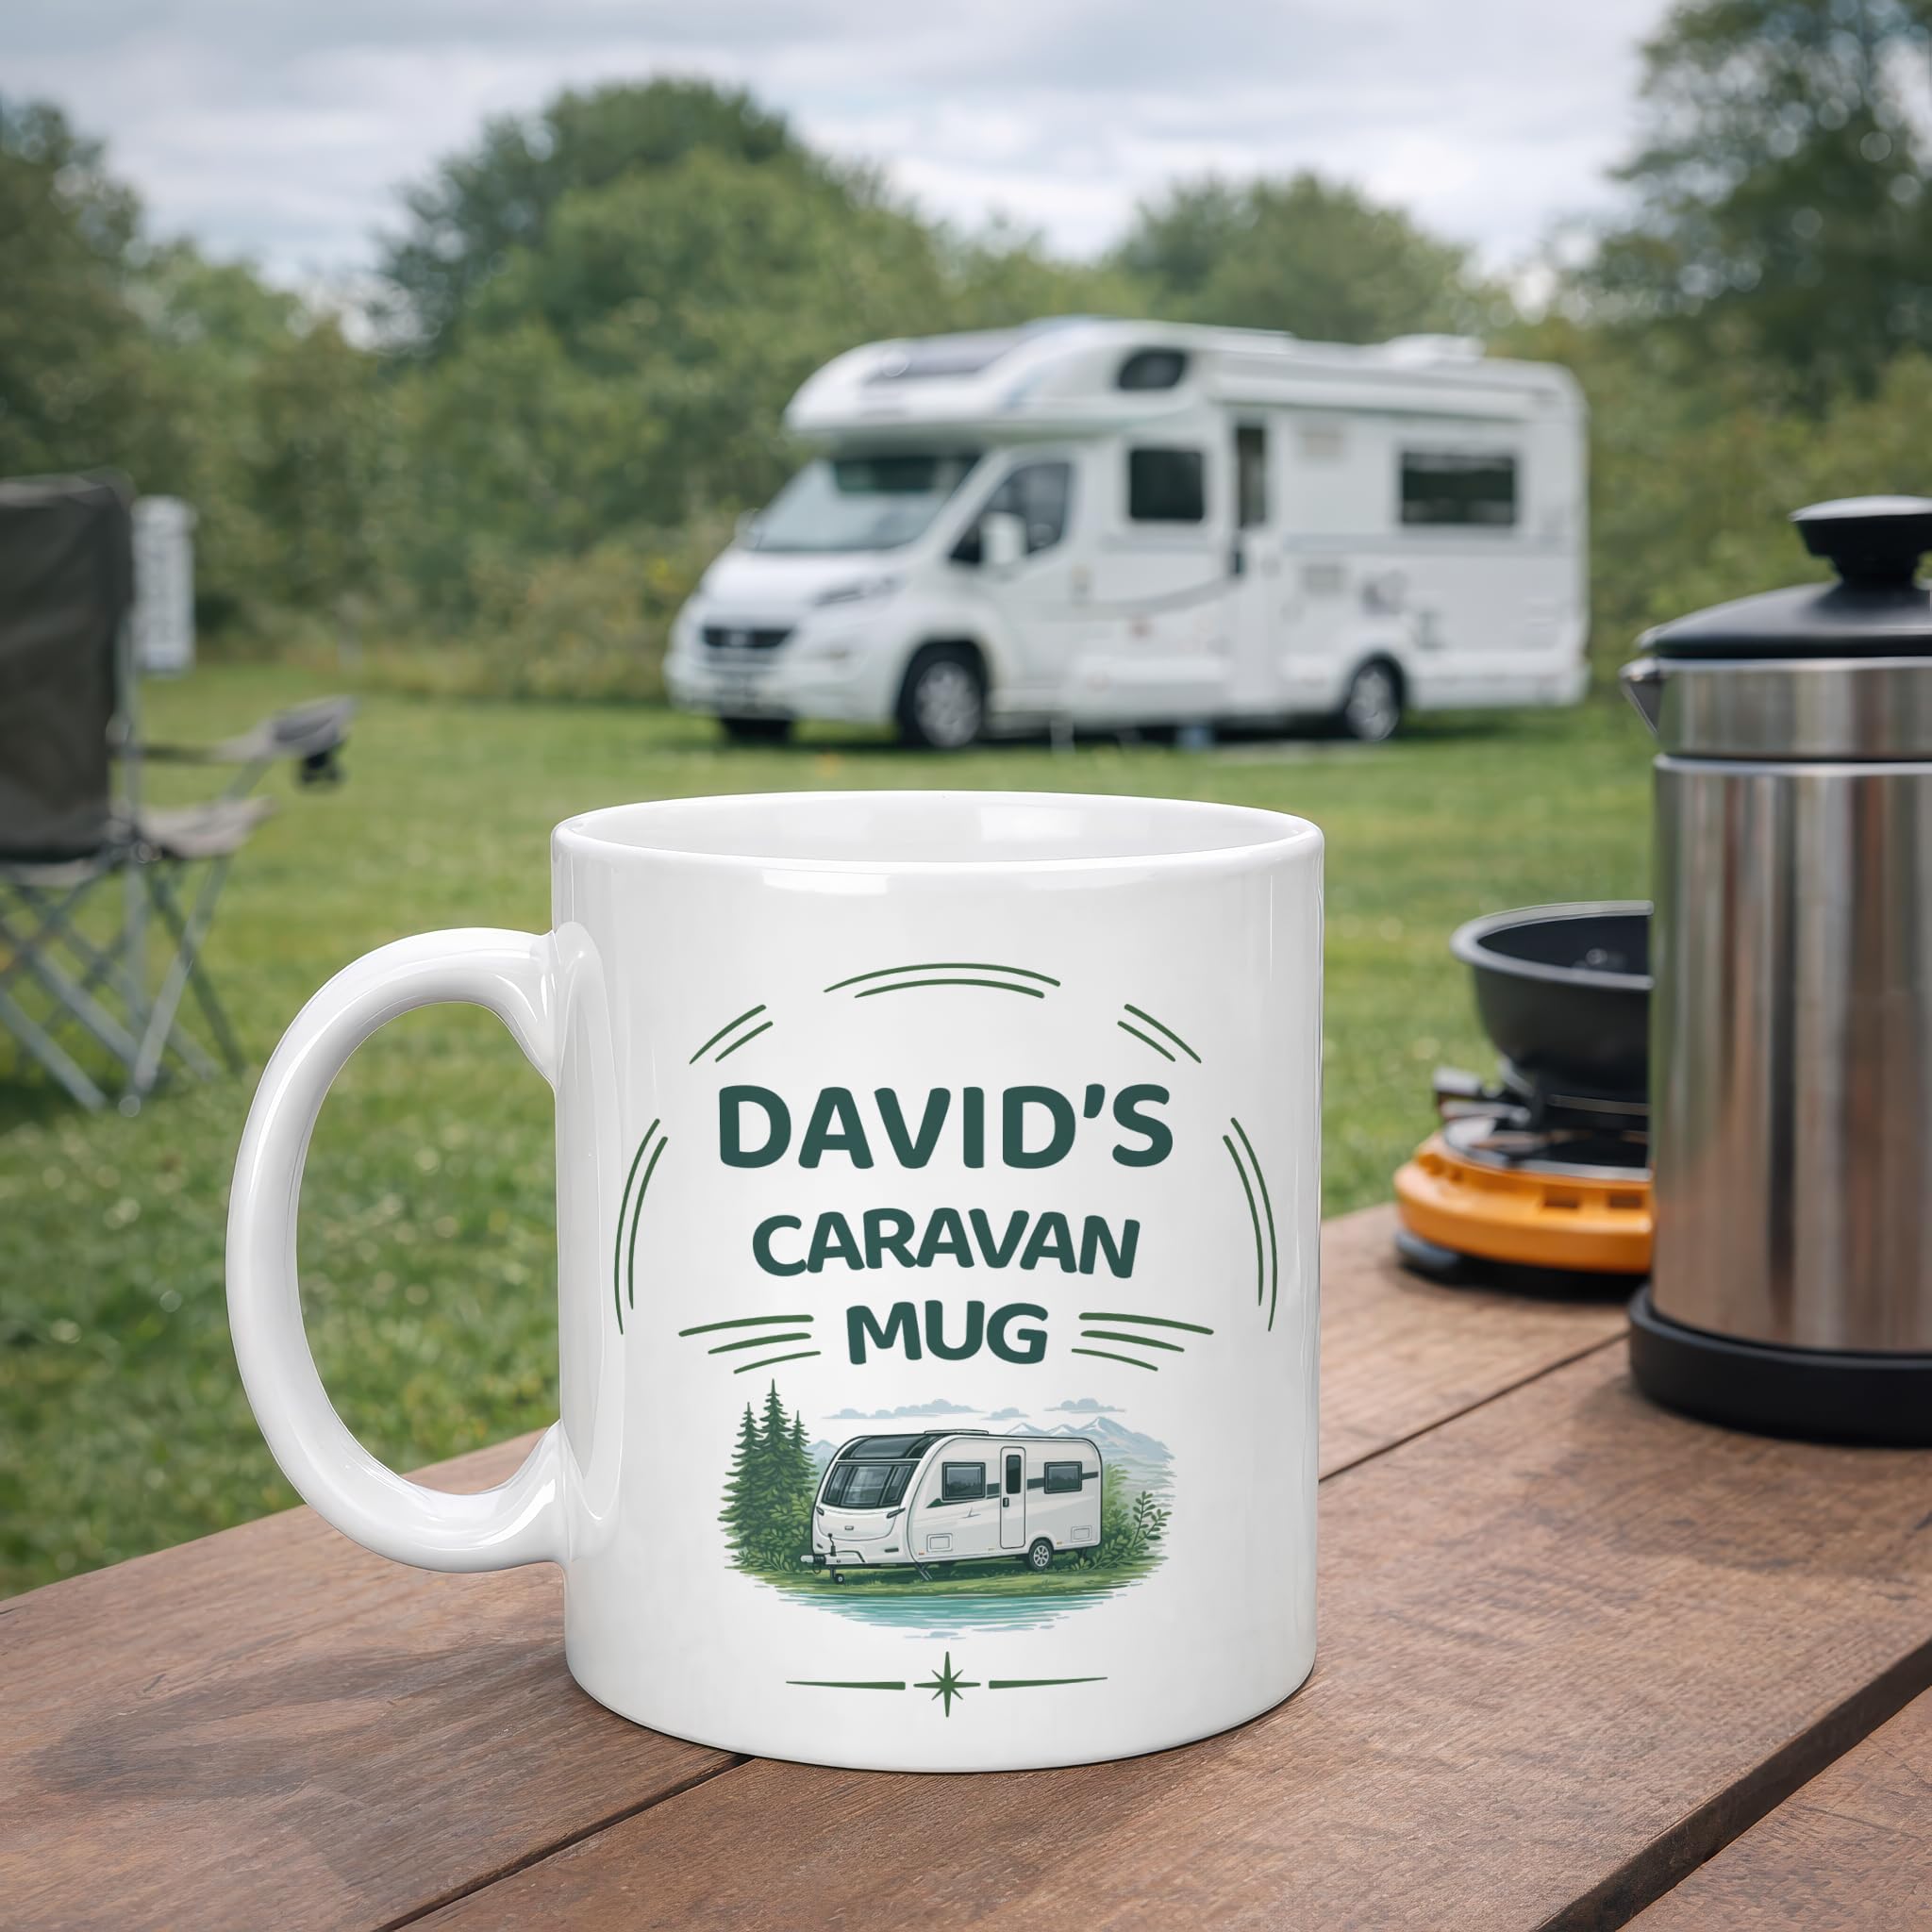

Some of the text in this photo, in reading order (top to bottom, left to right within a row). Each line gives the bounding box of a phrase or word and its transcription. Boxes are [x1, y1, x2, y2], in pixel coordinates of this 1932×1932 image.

[719, 1084, 1174, 1169] DAVID'S
[753, 1208, 1141, 1279] CARAVAN
[846, 1300, 1049, 1365] MUG
